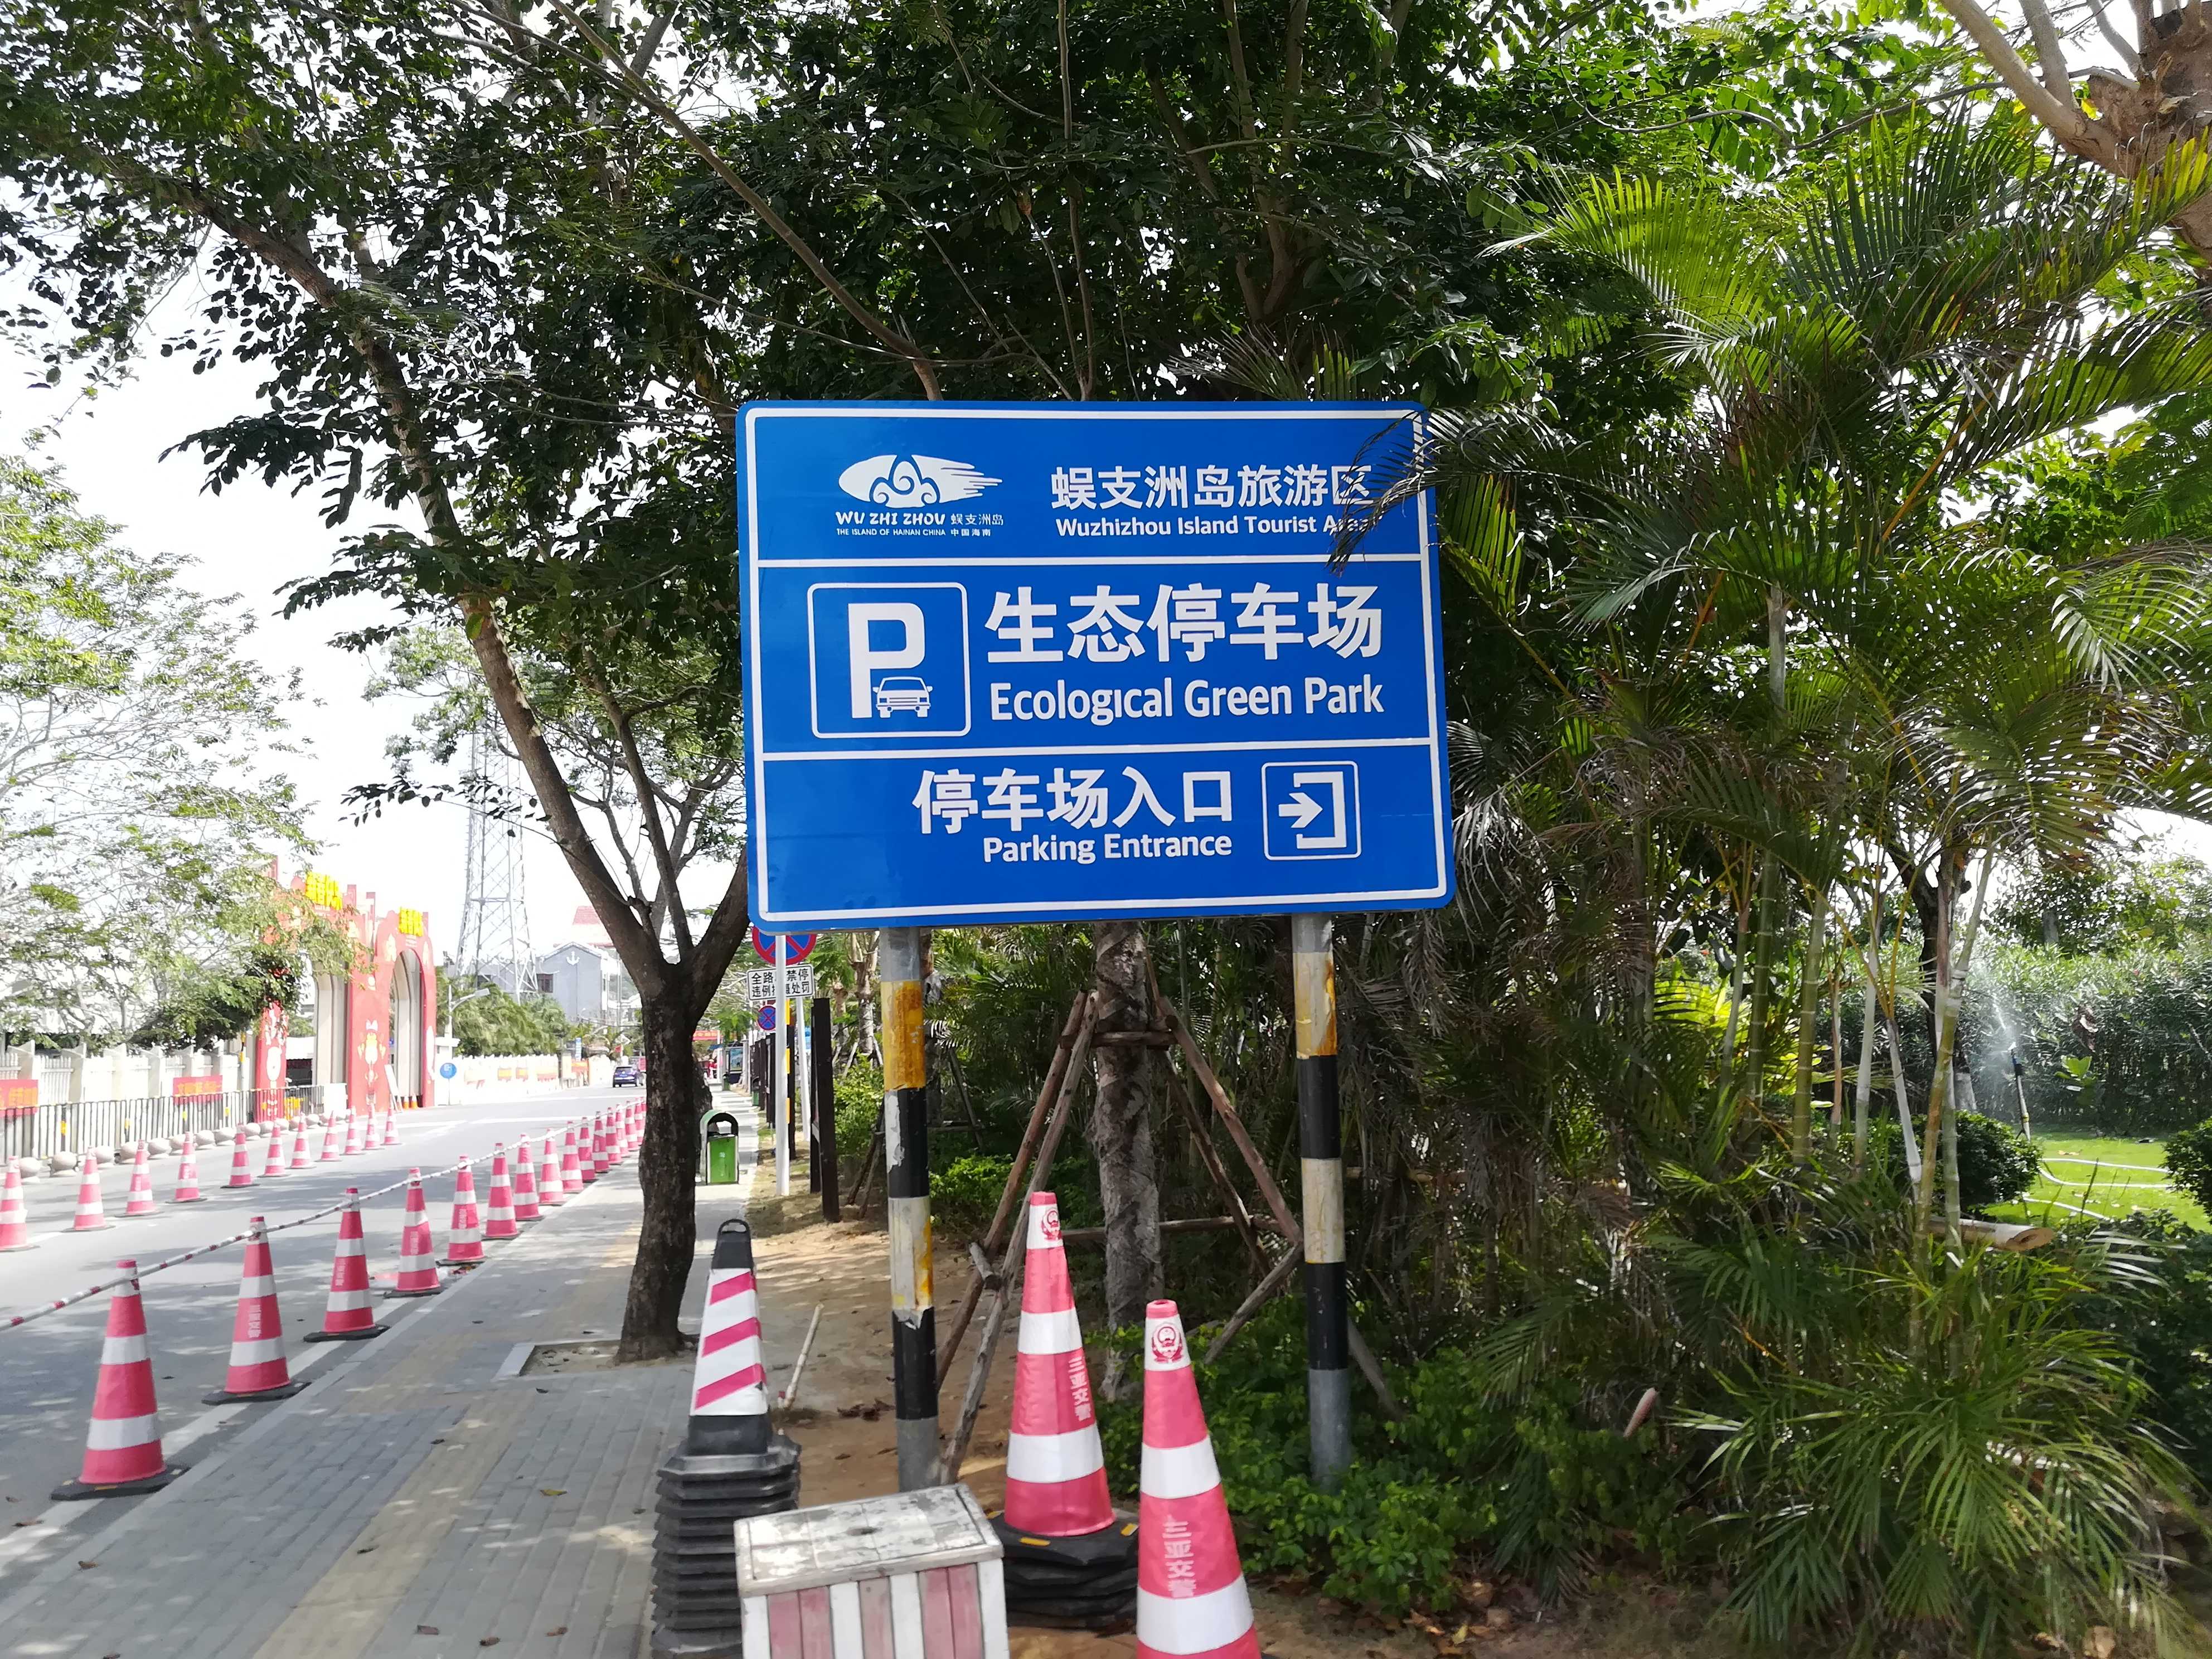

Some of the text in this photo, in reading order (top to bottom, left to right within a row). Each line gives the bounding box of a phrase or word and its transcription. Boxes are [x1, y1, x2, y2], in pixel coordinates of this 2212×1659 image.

[1051, 464, 1374, 510] 蜈支洲岛旅游区
[836, 511, 945, 525] WU ZHI ZHOU
[950, 513, 1003, 525] 蜈支洲岛
[1056, 517, 1171, 536] Wuzhizhou
[1178, 515, 1239, 535] Island
[1244, 516, 1317, 533] Tourist
[984, 582, 1382, 663] 生态停车场
[848, 603, 925, 718] P
[1185, 680, 1292, 717] Green
[1304, 674, 1384, 714] Park
[912, 766, 1232, 834] 停车场入口
[983, 833, 1232, 864] Parking Entrance
[751, 968, 809, 985] 全路禁停
[752, 981, 809, 997] 违例处罚
